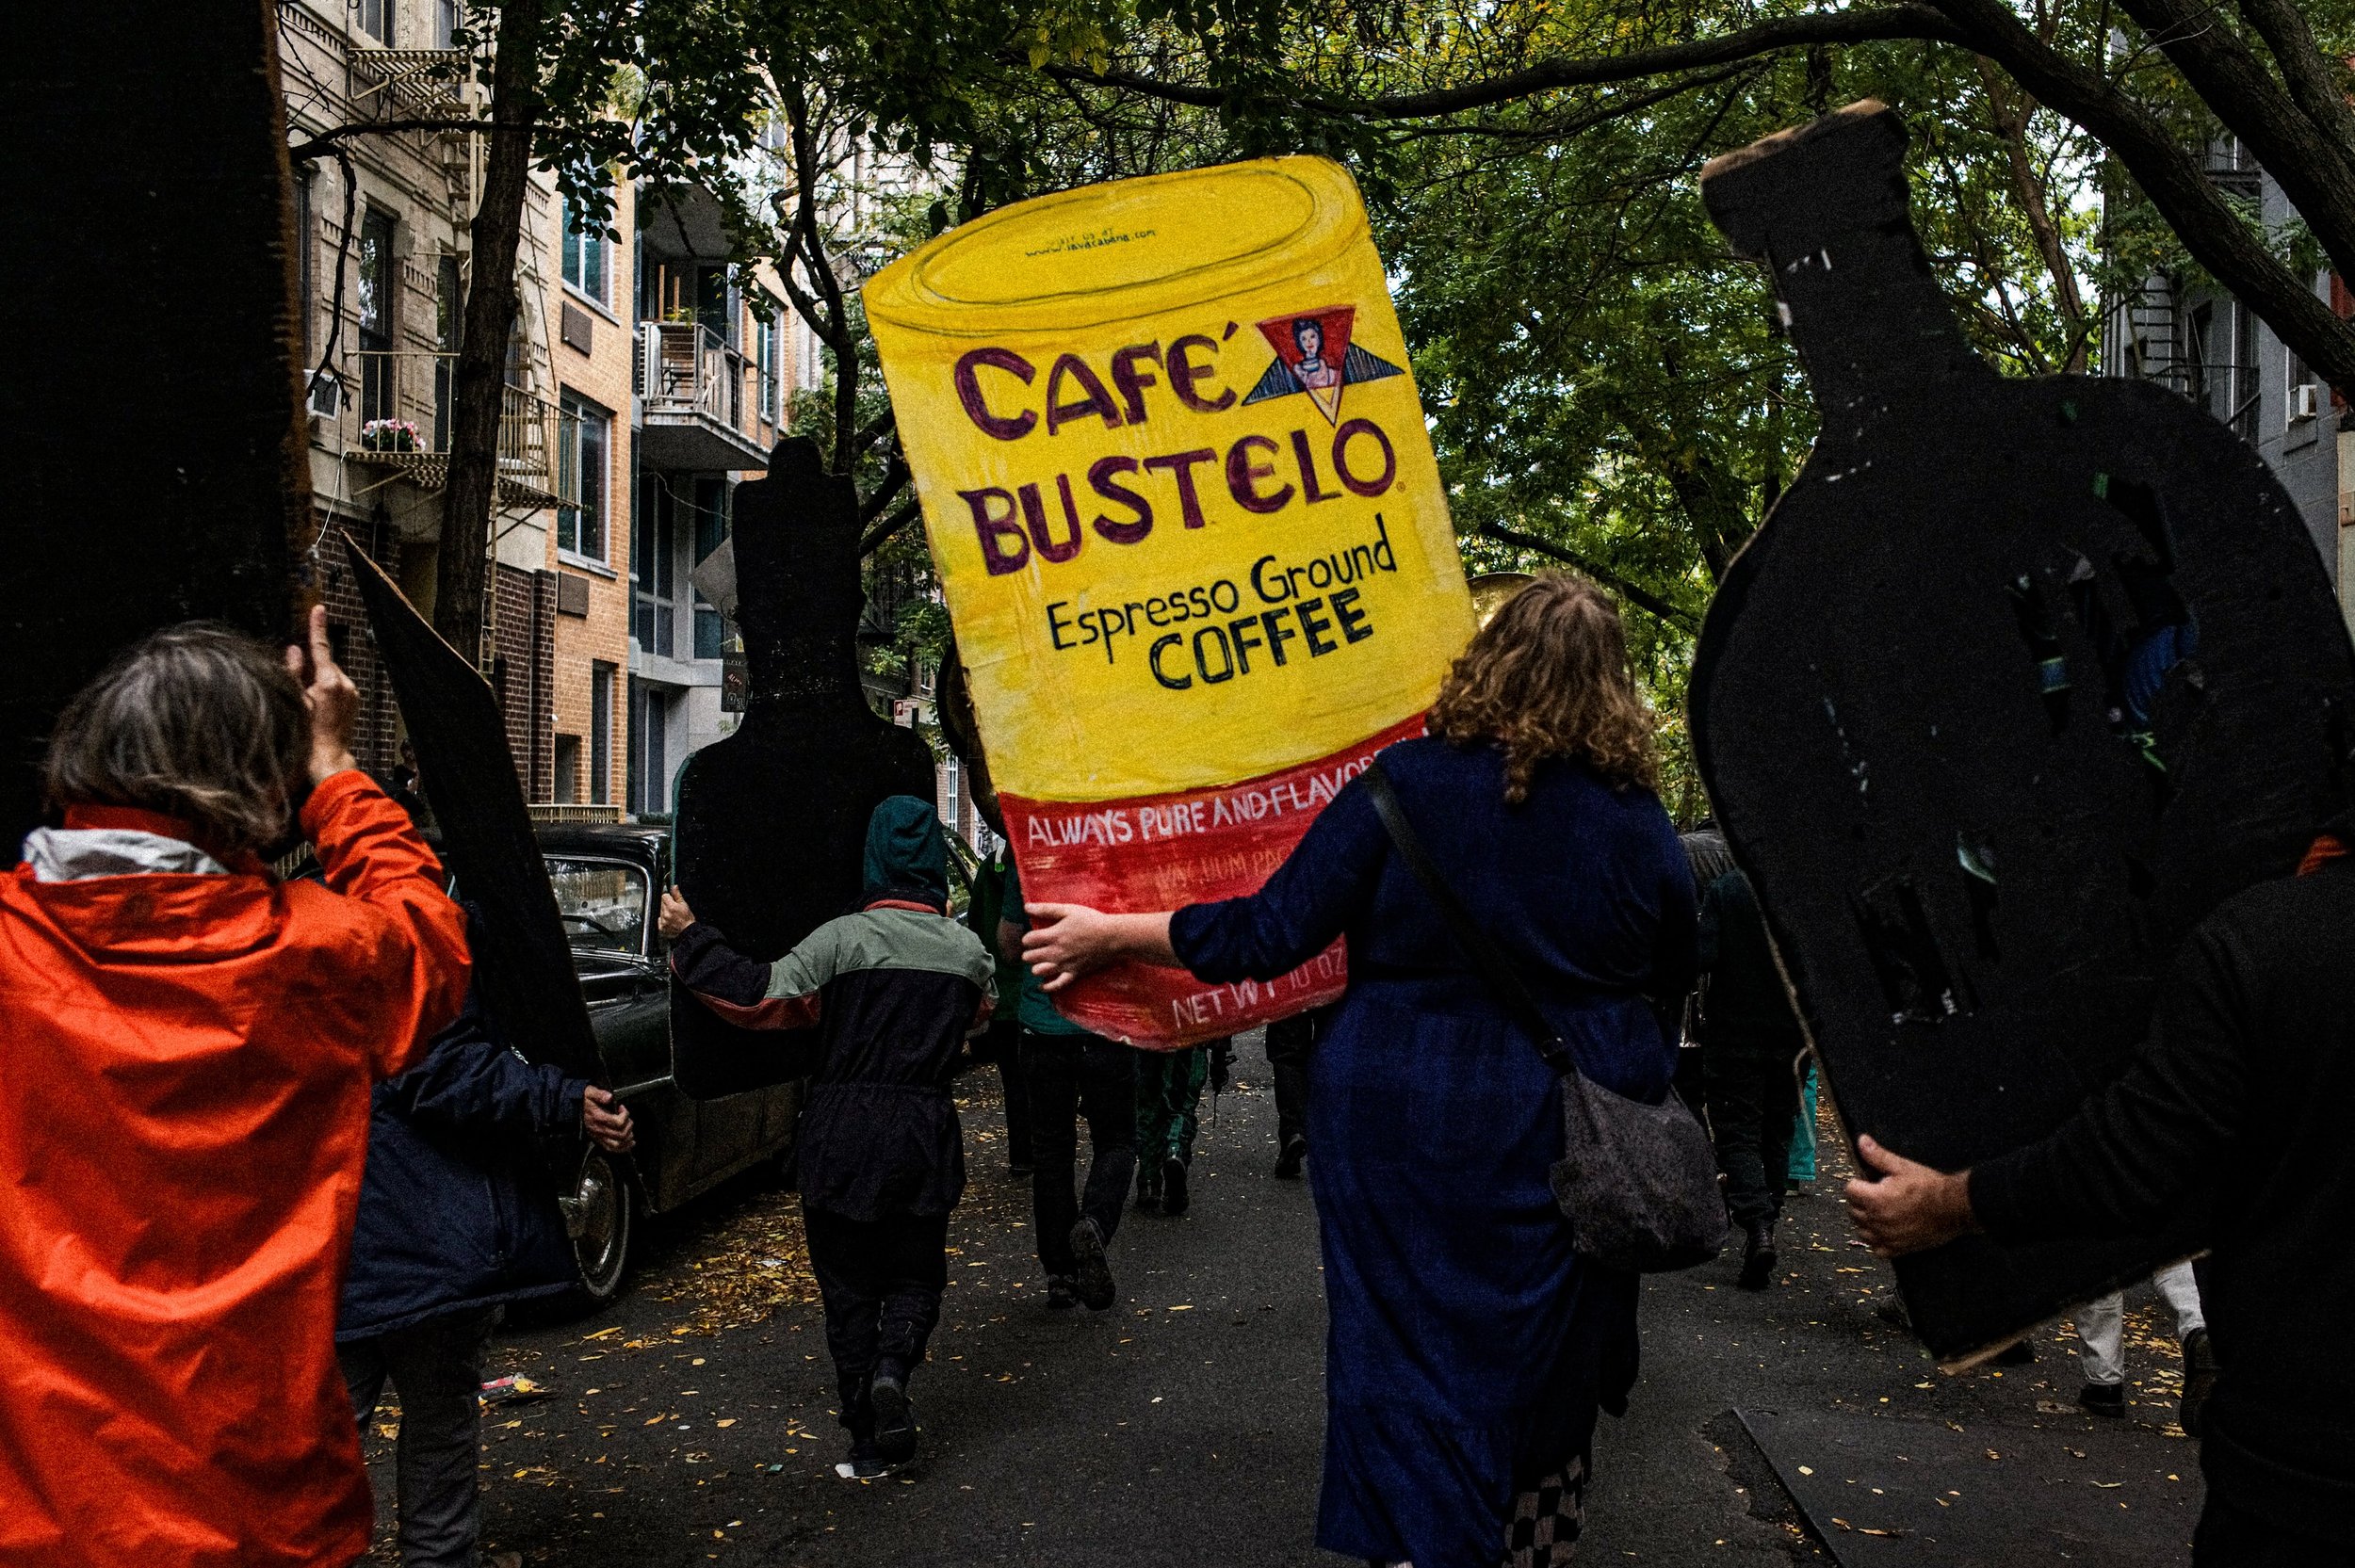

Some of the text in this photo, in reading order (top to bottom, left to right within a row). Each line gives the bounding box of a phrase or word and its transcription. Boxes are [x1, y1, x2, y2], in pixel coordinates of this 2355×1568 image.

[954, 321, 1240, 442] CAFÉ
[956, 418, 1397, 576] BUSTELO
[1046, 512, 1398, 665] Espresso Ground
[1148, 587, 1374, 690] COFFEE
[1028, 750, 1382, 848] ALWAYS PURE AND FLAVOR
[1172, 989, 1225, 1028] NET
